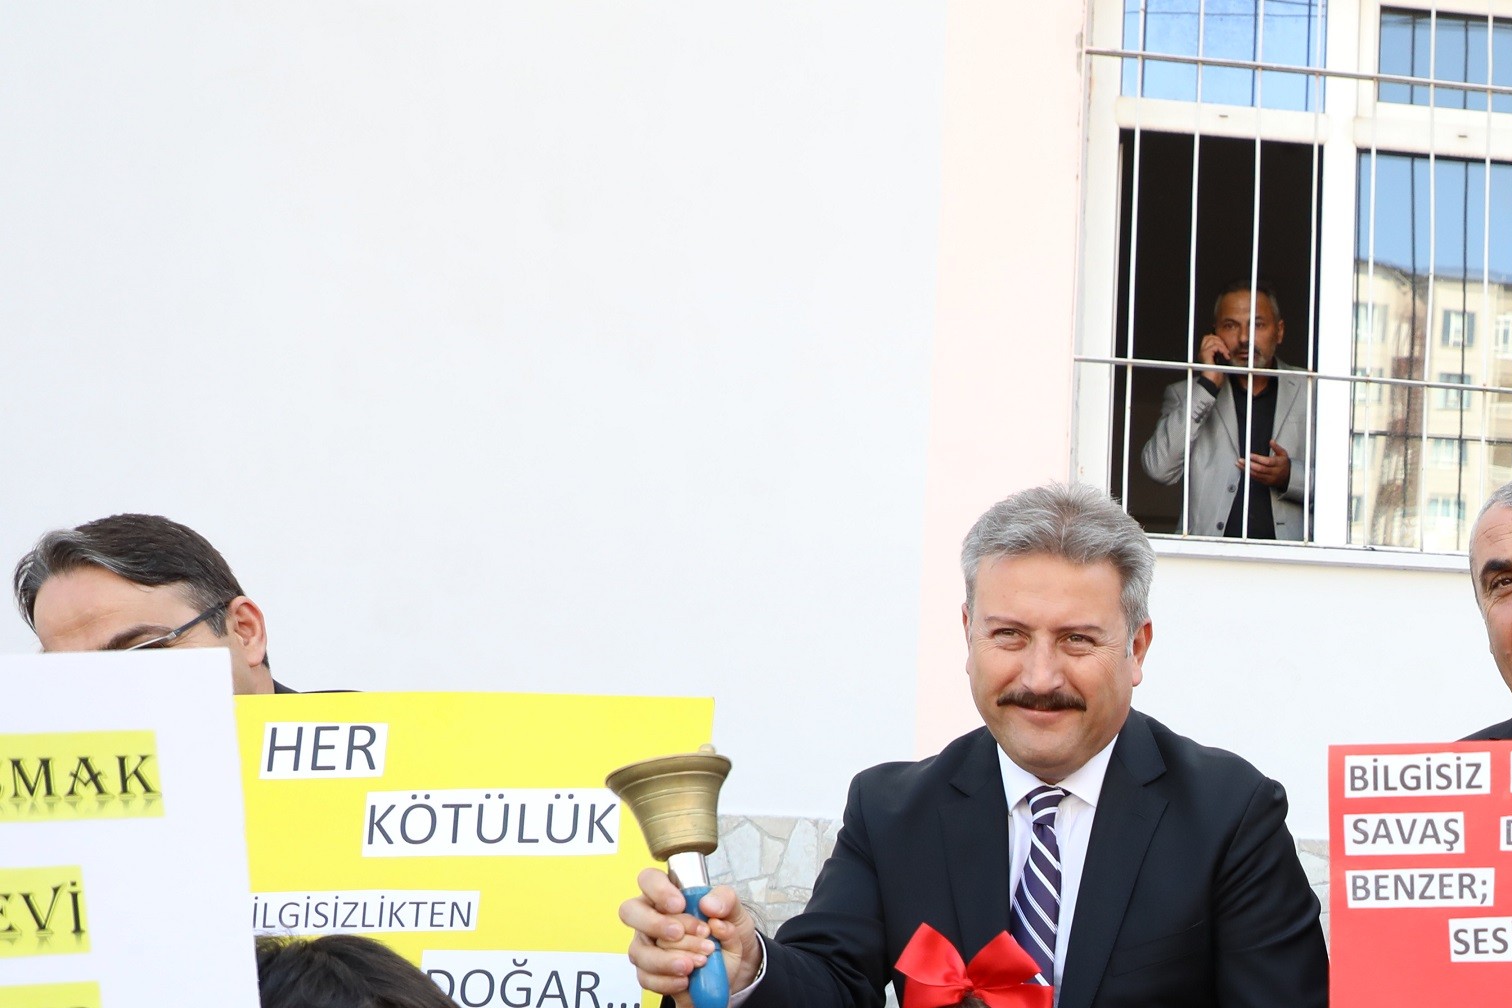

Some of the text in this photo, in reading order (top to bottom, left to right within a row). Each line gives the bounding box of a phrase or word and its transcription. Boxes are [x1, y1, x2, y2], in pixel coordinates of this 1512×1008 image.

[266, 725, 378, 773] HER
[0, 756, 160, 799] MAK
[1349, 756, 1483, 792] BİLGİSİZ
[367, 792, 616, 846] KÖTÜLÜK
[1352, 818, 1461, 852] SAVAŞ
[1351, 872, 1488, 905] BENZER;
